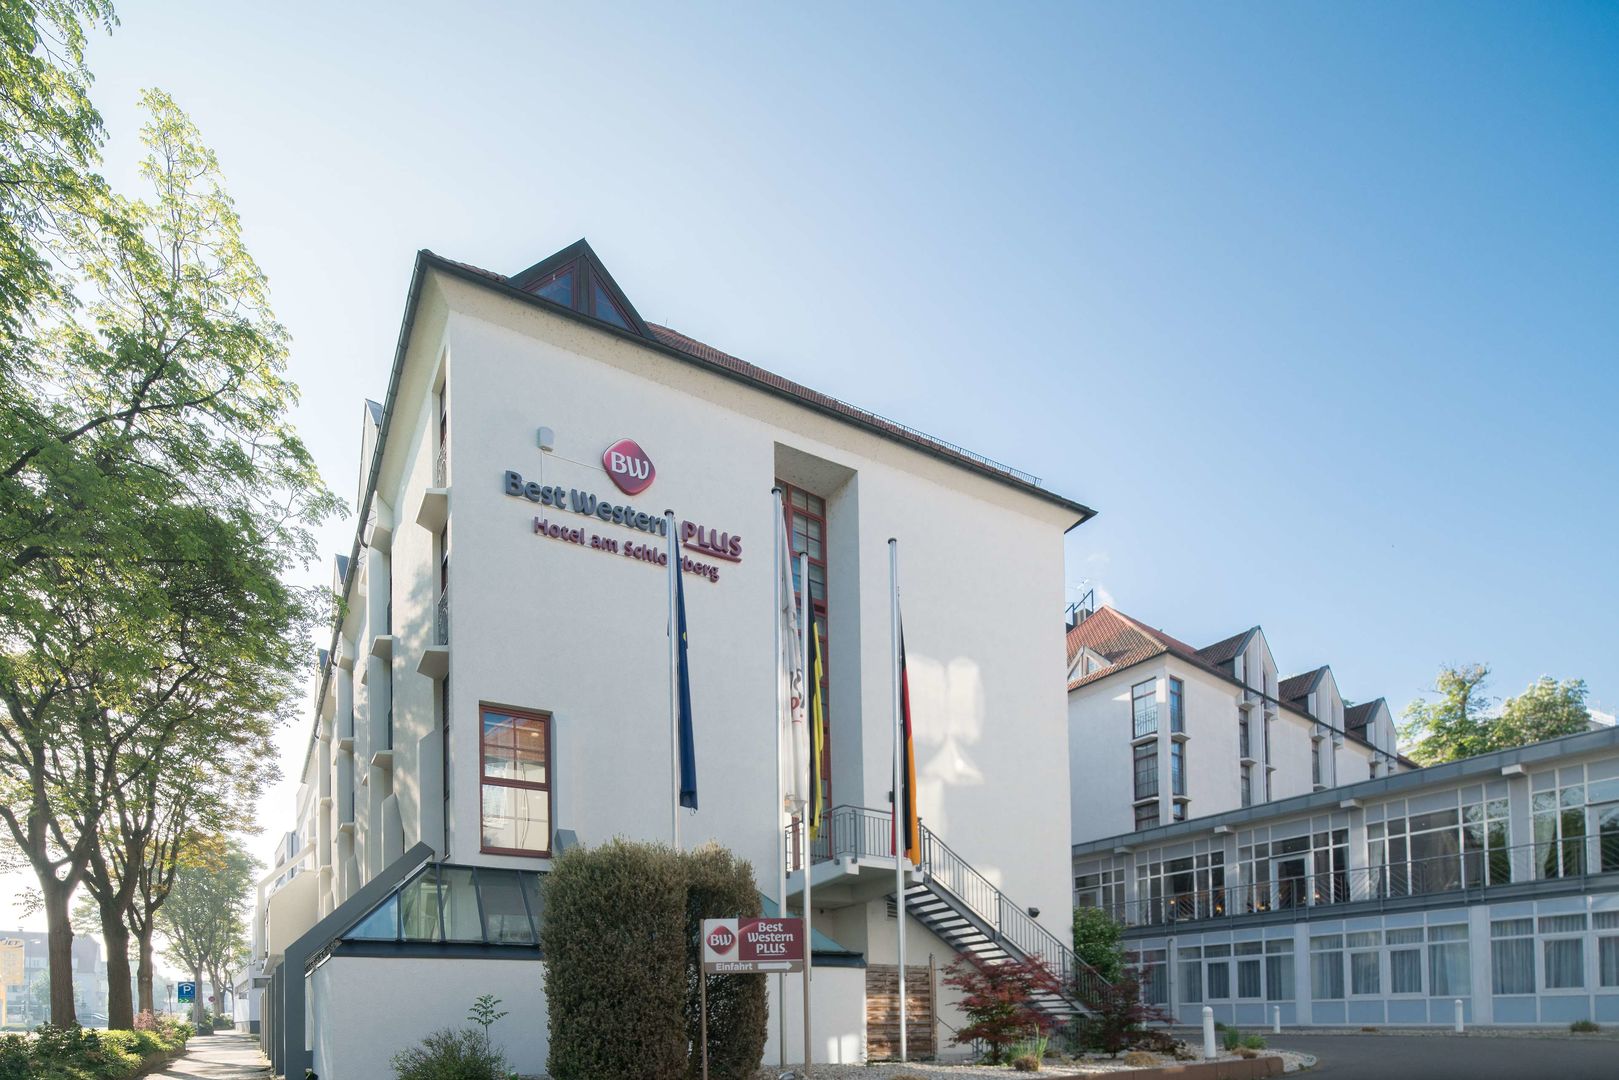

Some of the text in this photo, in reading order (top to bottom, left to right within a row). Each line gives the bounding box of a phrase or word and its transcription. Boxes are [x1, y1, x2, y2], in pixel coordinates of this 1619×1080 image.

[610, 451, 650, 480] BW
[505, 470, 566, 509] Best
[681, 520, 742, 557] PLUS
[533, 516, 720, 583] Hotel am Schloberg
[758, 922, 783, 932] Best
[710, 934, 732, 946] BW
[747, 932, 794, 942] Western
[756, 943, 786, 954] PLUS
[715, 962, 753, 971] Einfahrt
[183, 985, 192, 995] P
